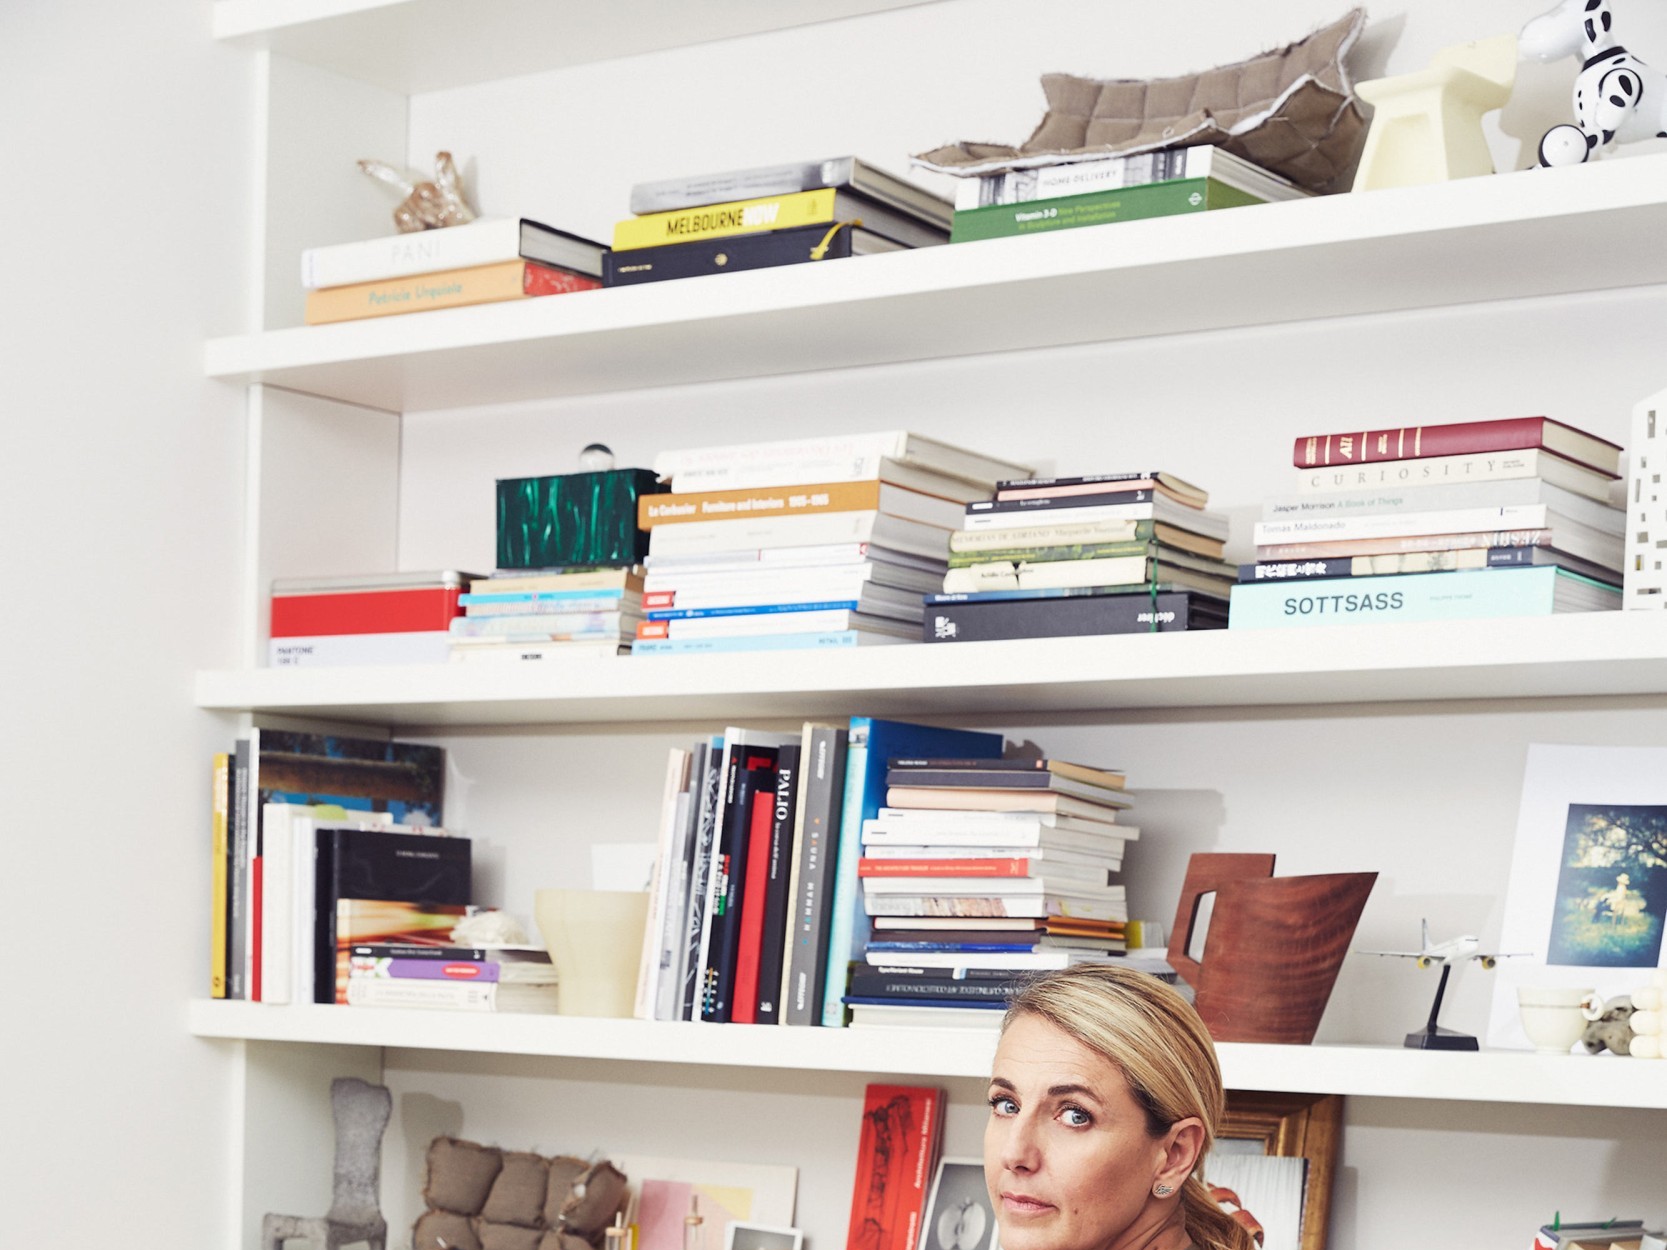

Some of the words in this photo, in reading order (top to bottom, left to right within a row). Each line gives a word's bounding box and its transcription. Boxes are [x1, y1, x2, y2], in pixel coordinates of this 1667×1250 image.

[665, 208, 744, 237] MELBOURNE
[743, 202, 780, 228] NOW
[1310, 459, 1499, 488] CURIOSITY
[1272, 503, 1299, 514] Jasper
[1301, 500, 1335, 512] Morrison
[1284, 591, 1404, 616] SOTTSASS
[775, 768, 791, 821] PALIO
